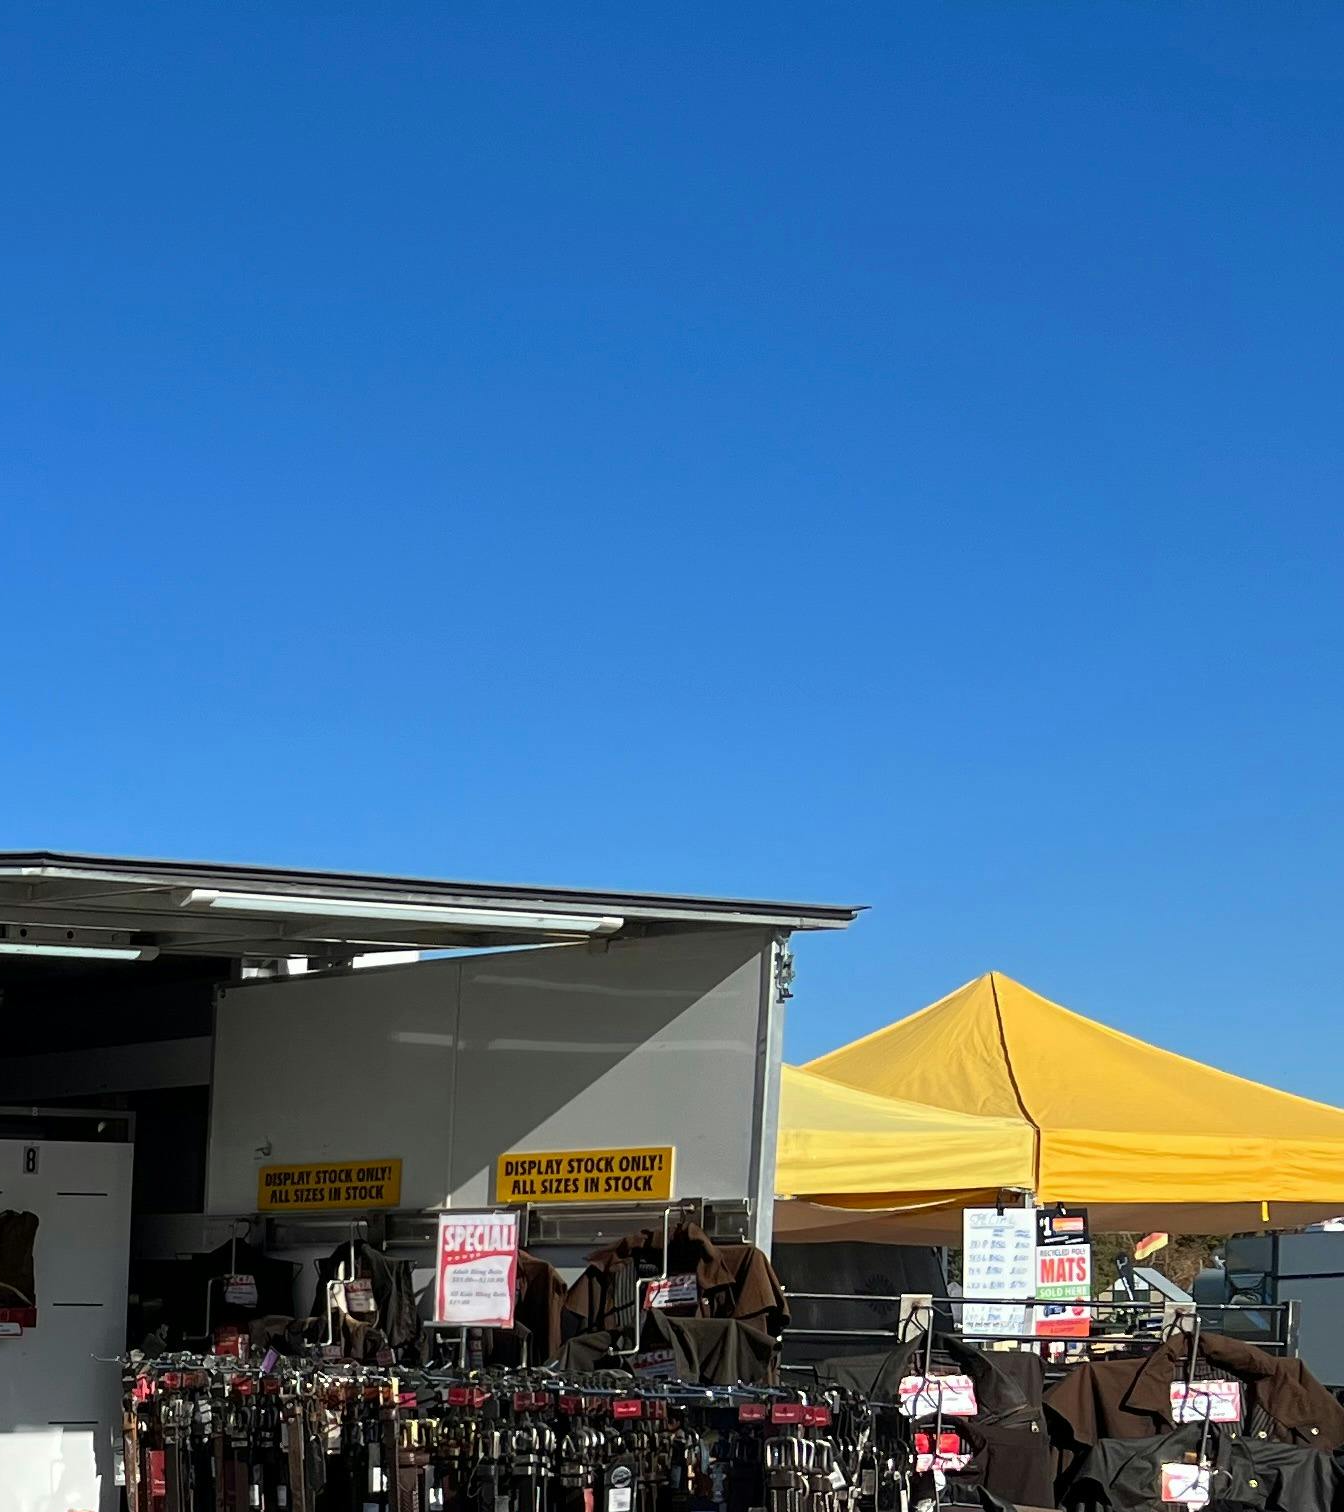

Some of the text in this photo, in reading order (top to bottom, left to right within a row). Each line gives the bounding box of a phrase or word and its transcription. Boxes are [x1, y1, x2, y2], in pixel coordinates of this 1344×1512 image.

[25, 1148, 36, 1171] 8
[505, 1154, 663, 1176] DISPLAY STOCK ONLY!
[265, 1166, 392, 1187] DISPLAY STOCK ONLY!
[512, 1175, 653, 1195] ALL SIZES IN STOCK
[270, 1185, 384, 1203] ALL SIZES IN STOCK
[444, 1225, 516, 1252] SPECIAL!
[1040, 1256, 1086, 1284] MATS
[1039, 1285, 1087, 1298] SOLD HERE
